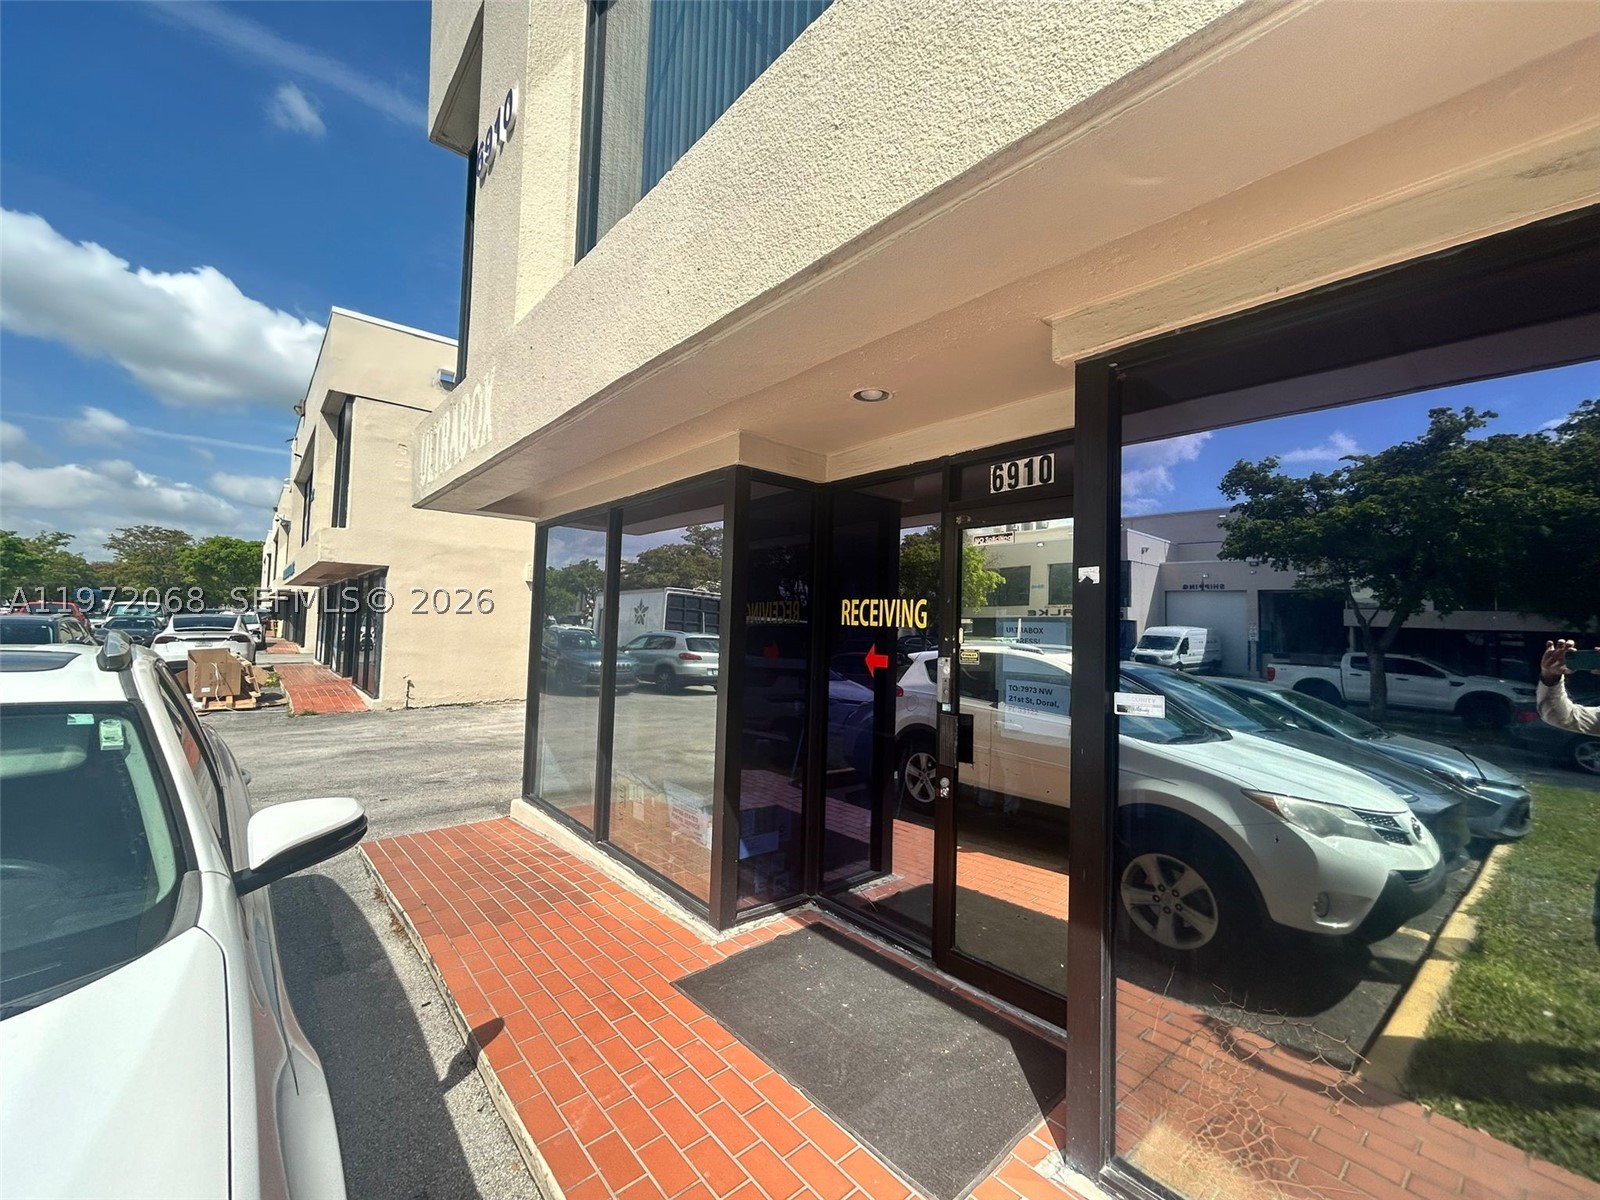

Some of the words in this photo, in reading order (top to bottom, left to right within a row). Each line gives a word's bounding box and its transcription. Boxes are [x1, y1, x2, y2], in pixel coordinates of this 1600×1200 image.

[477, 88, 517, 177] 6910
[991, 454, 1053, 492] 6910
[841, 599, 928, 629] RECEIVING
[1008, 695, 1024, 703] 21st
[1025, 697, 1035, 705] St,
[1036, 698, 1060, 708] Doral,
[1038, 688, 1054, 696] NW
